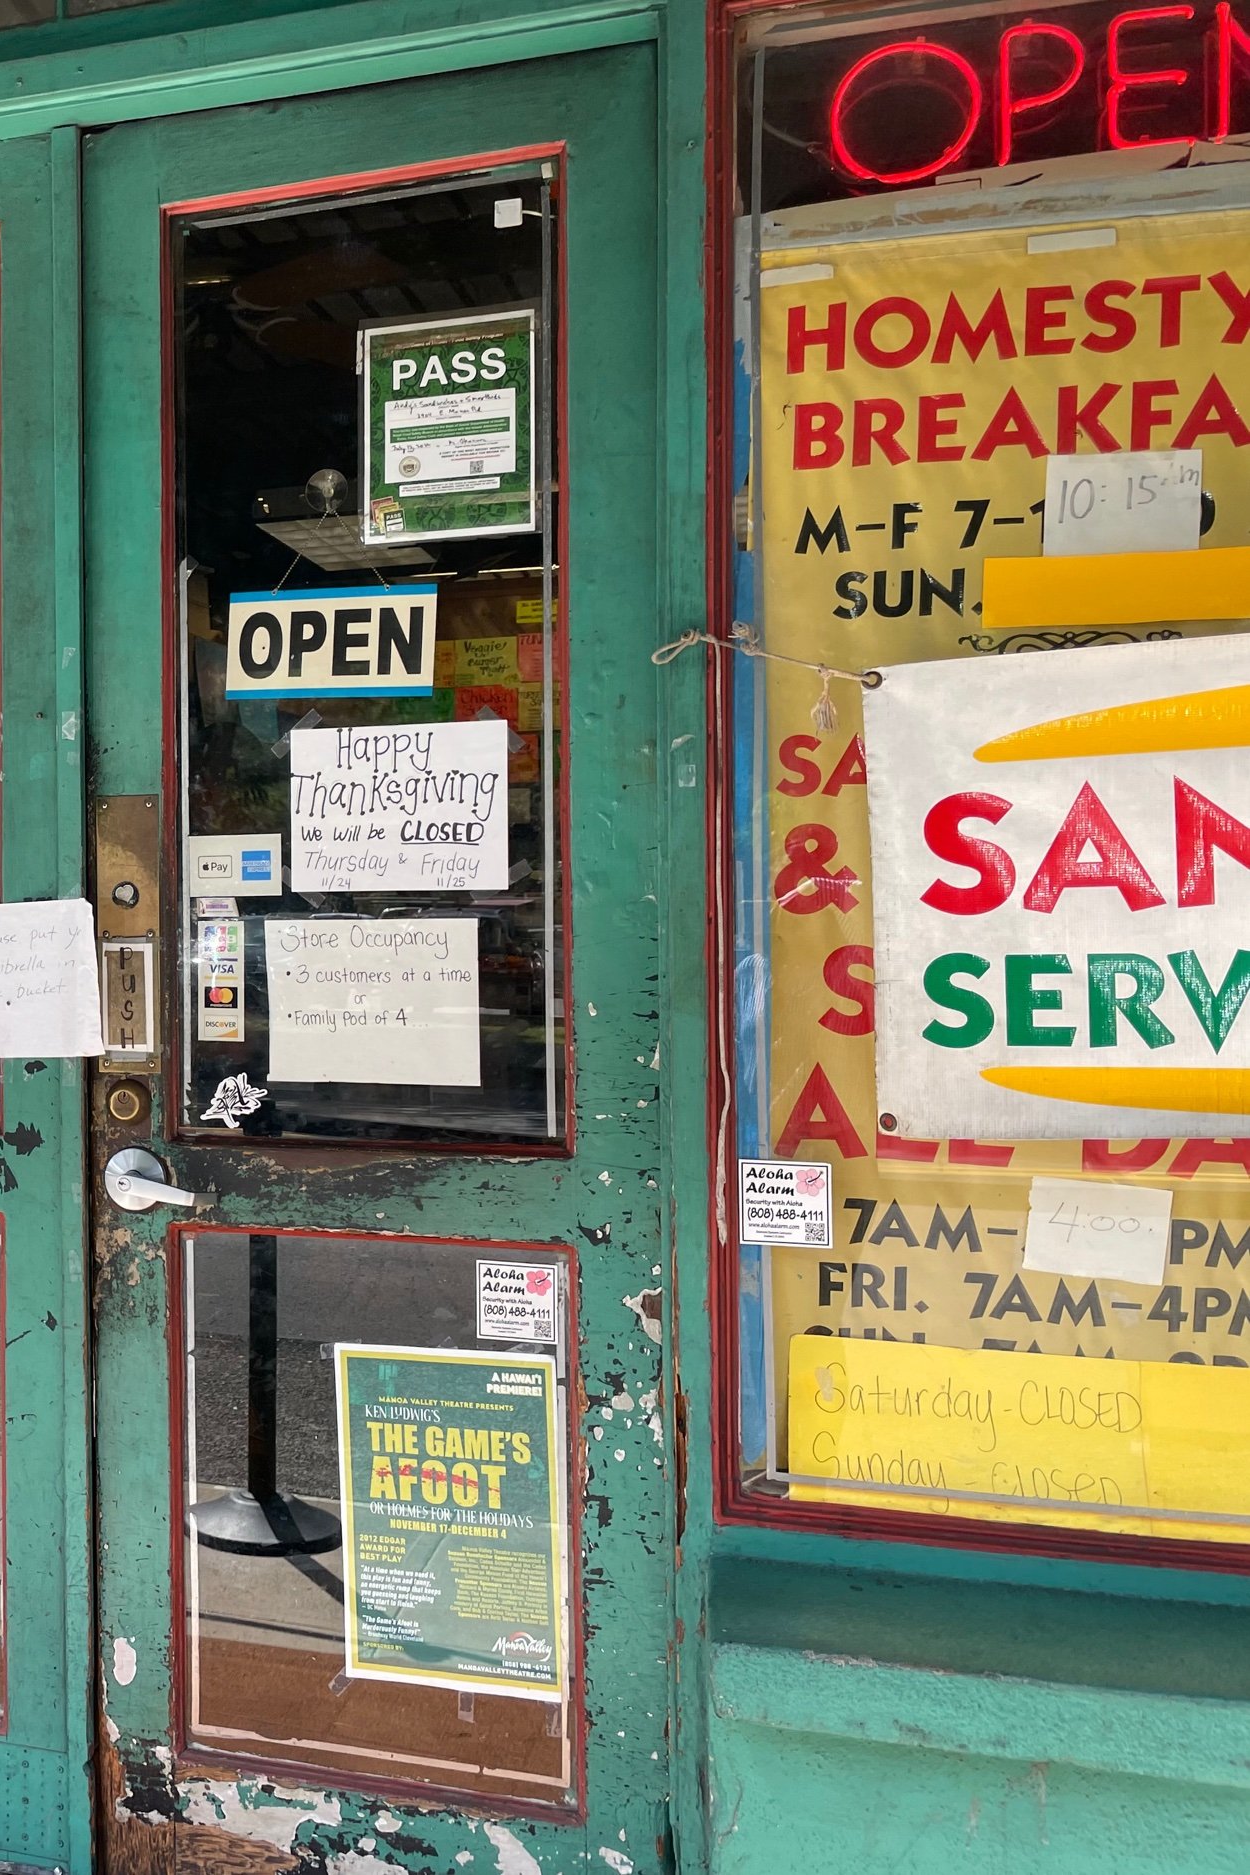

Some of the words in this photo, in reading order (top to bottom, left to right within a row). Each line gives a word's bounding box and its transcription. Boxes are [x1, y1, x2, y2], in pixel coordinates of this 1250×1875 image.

[392, 347, 507, 391] PASS
[792, 372, 1250, 471] BREAKFA
[795, 502, 923, 555] M-F
[239, 606, 424, 680] OPEN
[336, 728, 434, 773] Happy
[290, 769, 500, 822] Thanksgiving
[301, 825, 323, 842] We
[333, 825, 360, 842] will
[367, 825, 386, 840] be
[400, 821, 484, 843] CLOSED
[211, 862, 228, 873] Pay
[305, 850, 390, 876] Thursday
[398, 852, 408, 866] &
[420, 852, 481, 879] Friday
[774, 823, 861, 914] &
[321, 877, 351, 890] 11/24
[436, 876, 466, 888] 11/25
[29, 926, 55, 949] put
[279, 924, 339, 953] Store
[350, 924, 449, 960] Occupancy
[210, 964, 234, 974] VISA
[295, 965, 309, 984] 3
[315, 968, 391, 984] customers
[402, 968, 416, 982] at
[423, 972, 432, 983] a
[438, 967, 472, 983] time
[119, 946, 136, 1049] PUSH
[354, 993, 367, 1005] or
[921, 948, 1250, 1055] SERV
[205, 1021, 237, 1029] DISCOVER
[294, 1011, 337, 1033] Family
[374, 1010, 389, 1025] of
[396, 1009, 408, 1027] 4
[746, 1167, 794, 1180] Aloha
[745, 1182, 795, 1196] Alarm
[786, 1199, 803, 1207] Aloha
[747, 1206, 774, 1222] (808)
[775, 1208, 823, 1222] 488-4111
[483, 1267, 525, 1281] Aloha
[482, 1281, 525, 1296] Alarm
[818, 1261, 930, 1314] FRI.
[484, 1304, 508, 1318] (808)
[508, 1306, 551, 1319] 488-4111
[491, 1372, 500, 1382] A
[486, 1384, 543, 1397] PREMIERE!
[365, 1404, 387, 1418] KEN
[390, 1406, 441, 1422] LUDWIG'S
[379, 1396, 408, 1404] MANOA
[410, 1398, 438, 1406] VALLEY
[440, 1400, 474, 1409] THEATRE
[475, 1402, 514, 1412] PRESENTS
[815, 1362, 999, 1452] Saturday
[1019, 1380, 1142, 1434] CLOSED
[366, 1421, 419, 1455] THE
[425, 1425, 532, 1464] GAME'S
[812, 1430, 950, 1514] Sunday
[370, 1455, 507, 1510] AFOOT
[370, 1501, 384, 1514] OR
[388, 1503, 429, 1519] HOLMES
[431, 1507, 450, 1521] FOR
[454, 1508, 477, 1523] THE
[479, 1511, 534, 1529] HOLIDAYS
[390, 1518, 437, 1533] NOVEMBER
[439, 1524, 495, 1538] 17-DECEMBER
[497, 1529, 507, 1539] 4
[359, 1534, 378, 1542] 2012
[379, 1535, 406, 1545] EDGAR
[359, 1544, 389, 1552] AWARD
[390, 1546, 406, 1554] FOR
[359, 1552, 380, 1560] BEST
[382, 1554, 403, 1563] PLAY
[458, 1663, 552, 1680] MANOAVALLEYTHEATRE.COM
